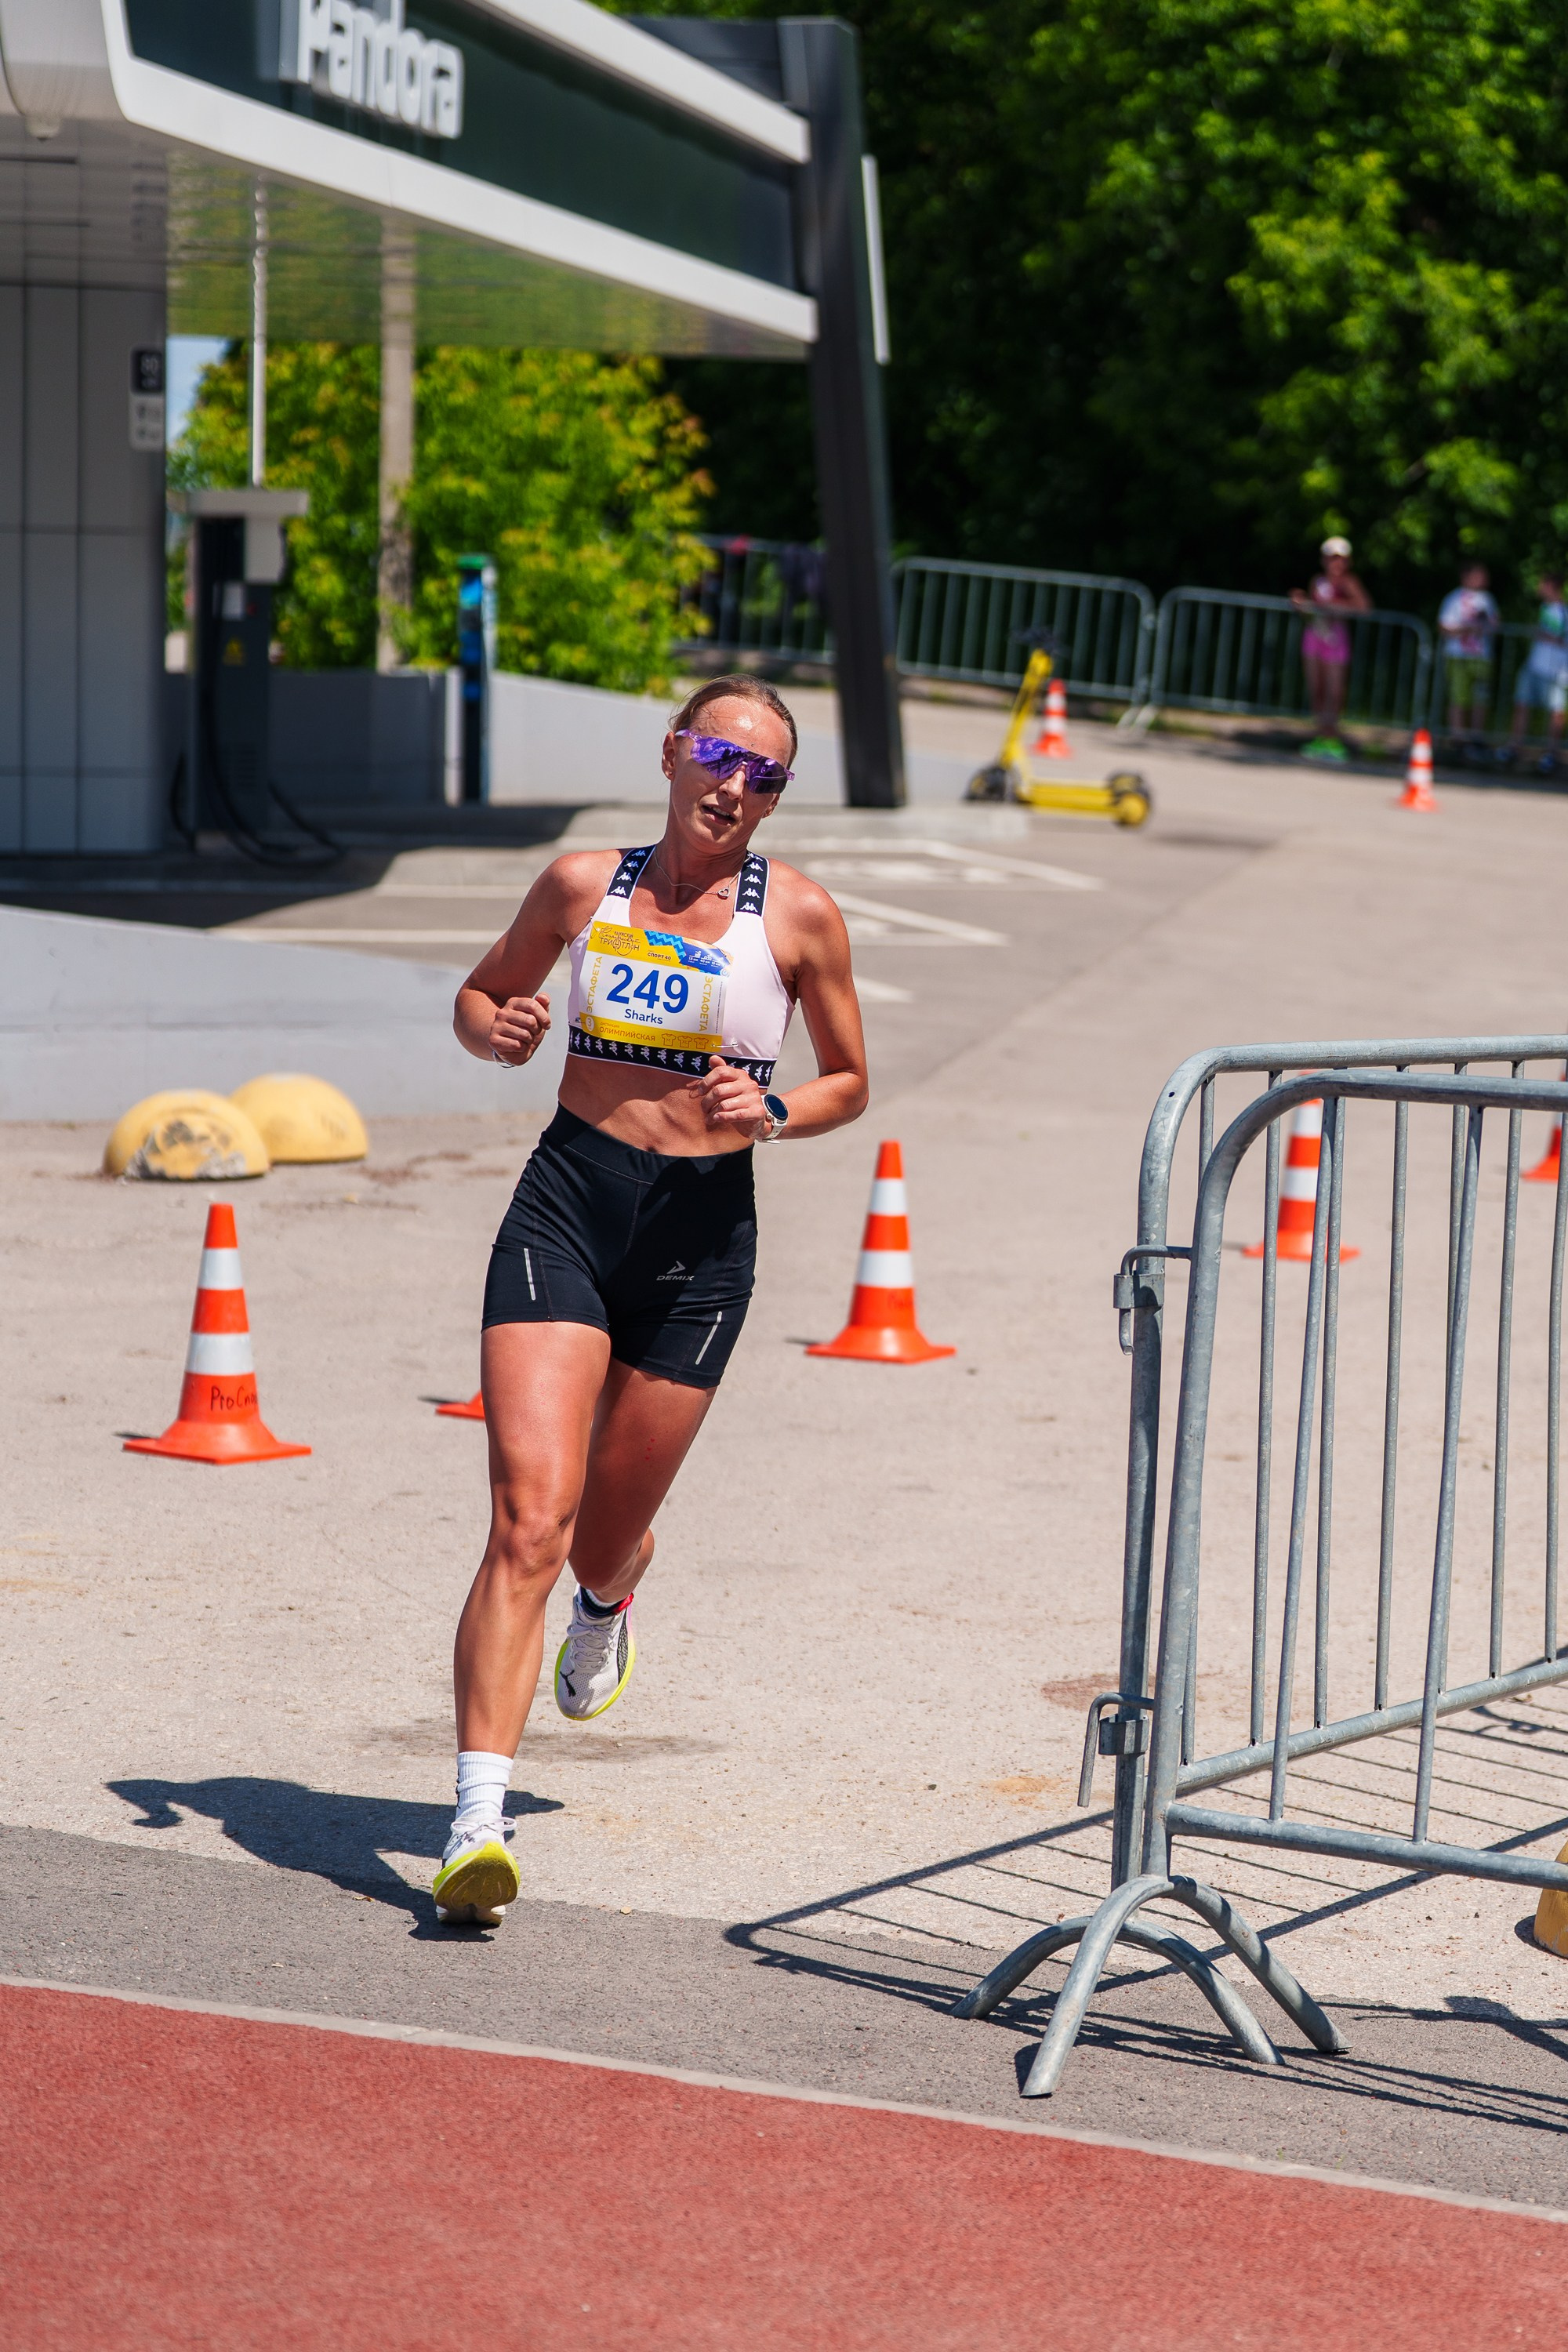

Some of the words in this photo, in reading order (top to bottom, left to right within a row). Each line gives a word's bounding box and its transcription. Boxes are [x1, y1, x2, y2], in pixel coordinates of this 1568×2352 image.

[297, 0, 464, 140] Pandora
[600, 937, 640, 951] ТРИАТЛОН
[586, 956, 602, 1013] ЭСТАФЕТА
[606, 964, 689, 1014] 249
[699, 975, 713, 1032] ЭСТАФЕТА
[599, 1026, 655, 1041] ОЛИМПИЙСКАЯ
[624, 1008, 663, 1024] Sharks
